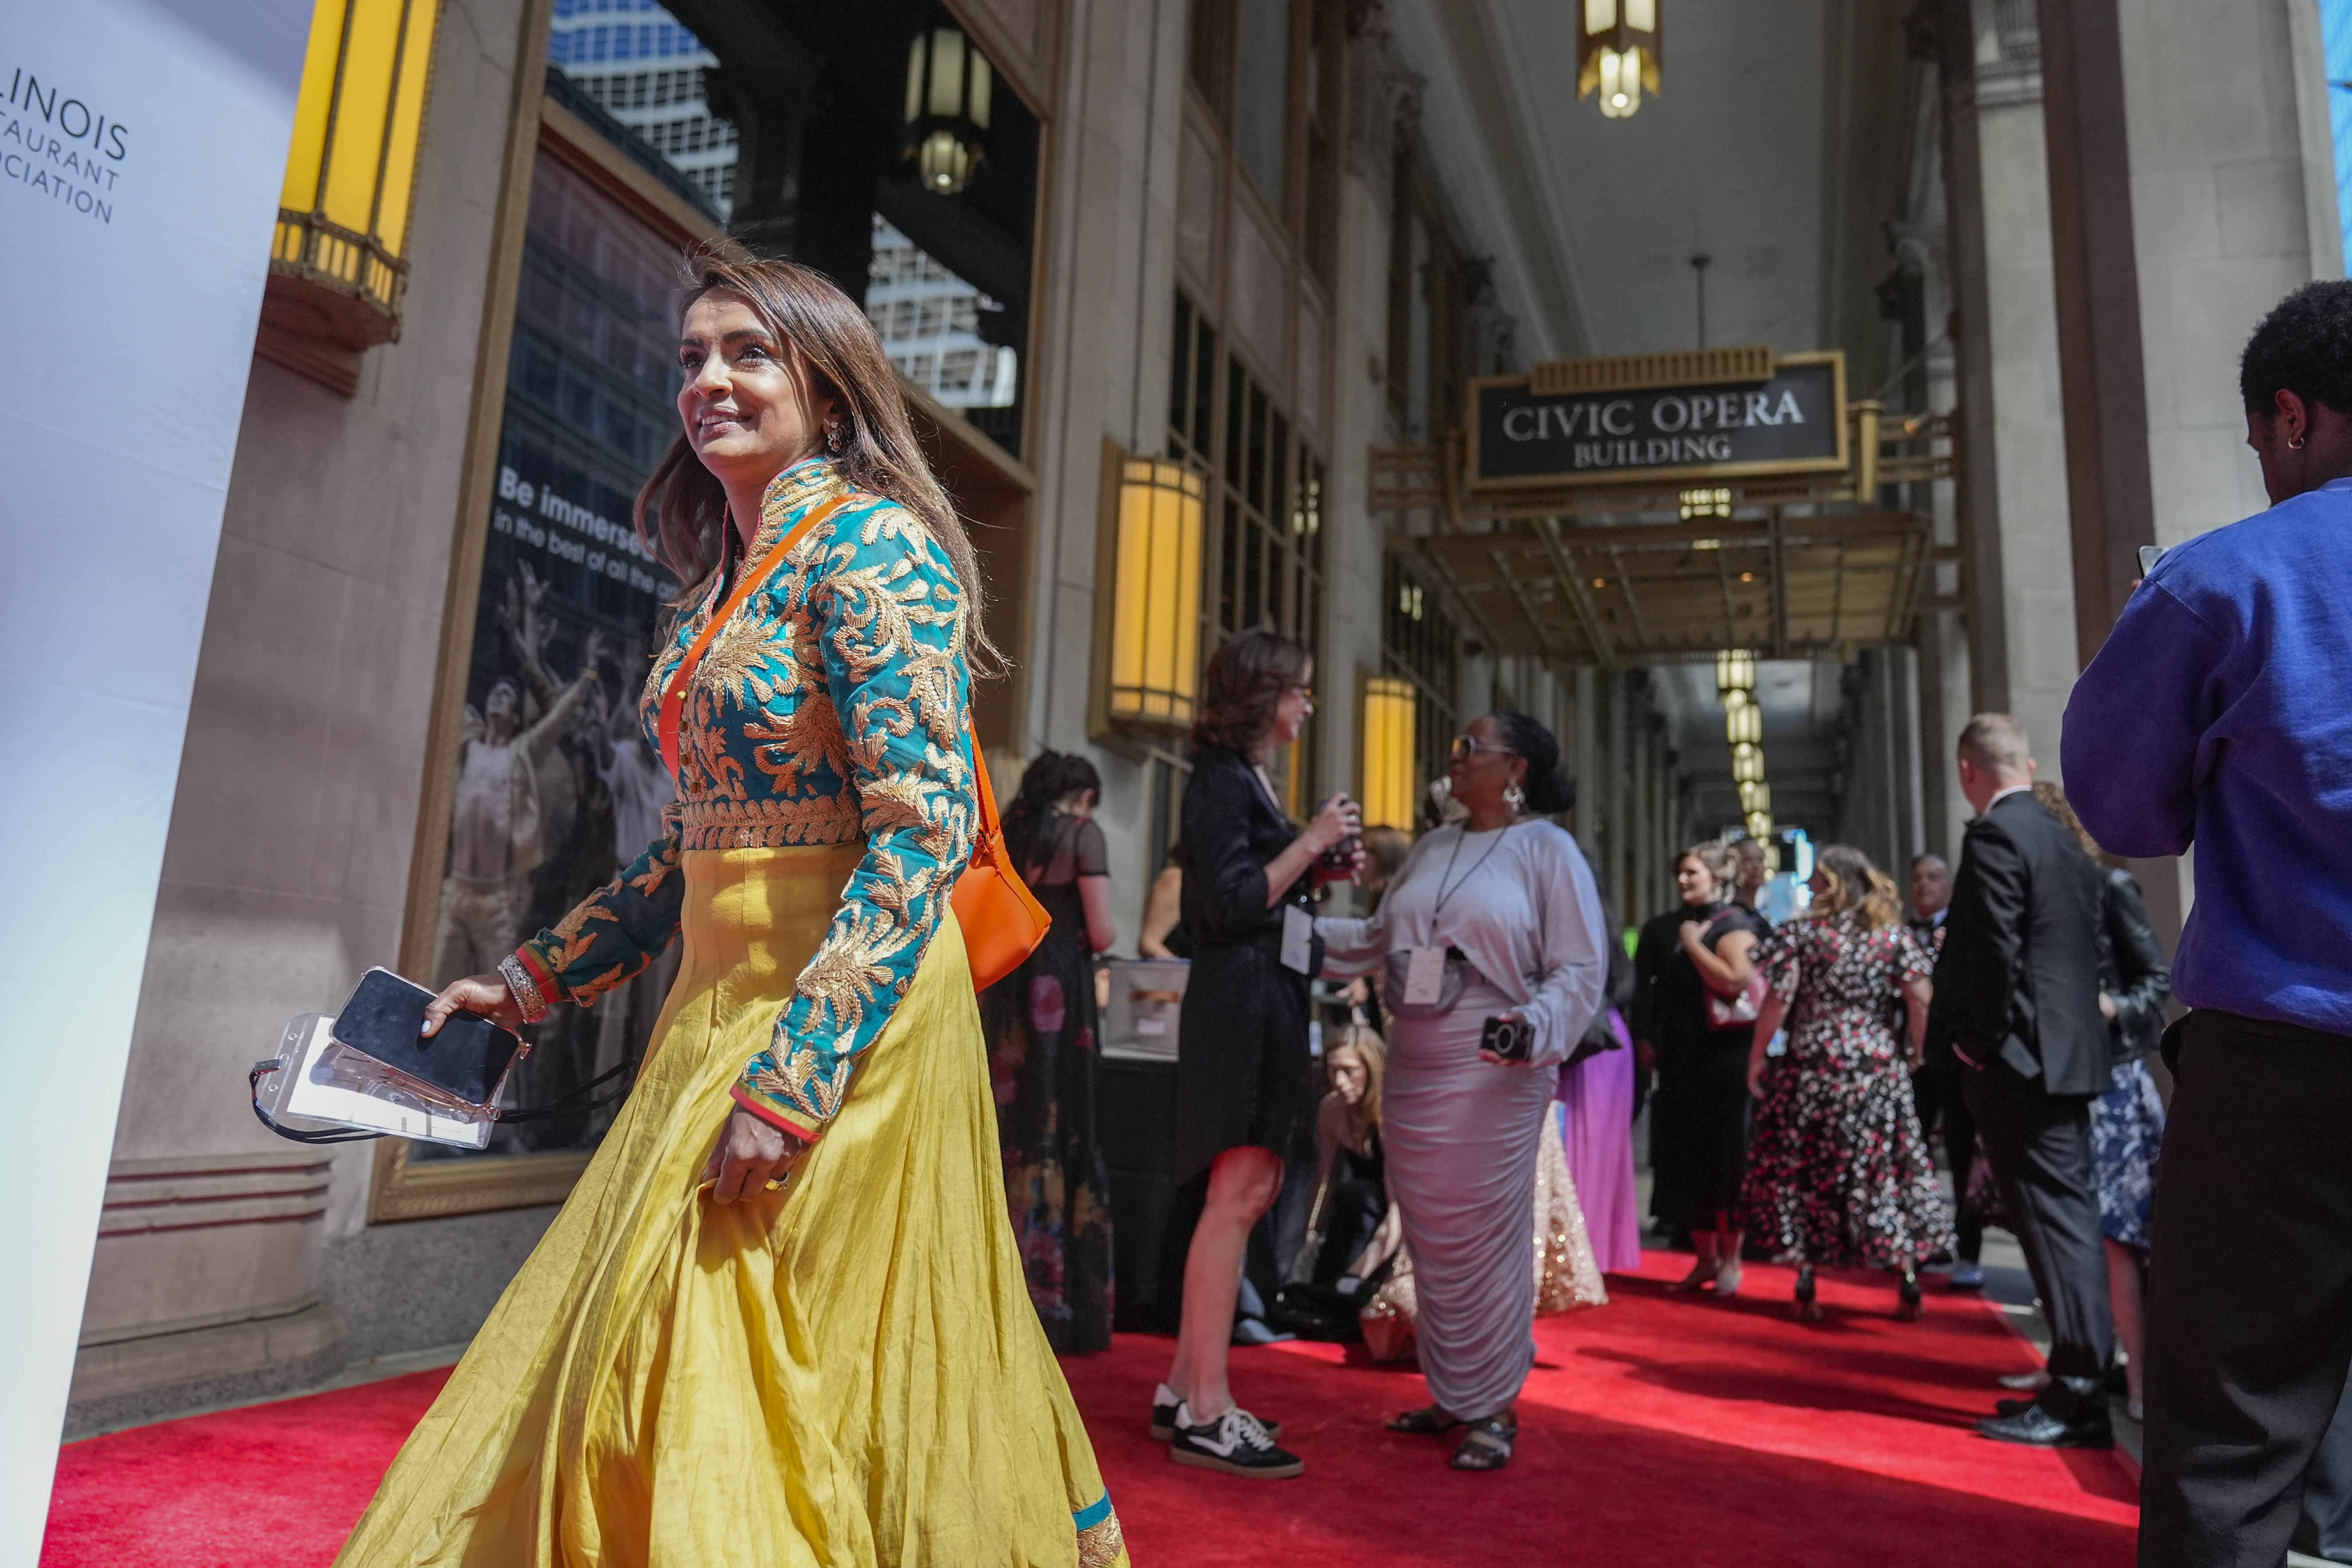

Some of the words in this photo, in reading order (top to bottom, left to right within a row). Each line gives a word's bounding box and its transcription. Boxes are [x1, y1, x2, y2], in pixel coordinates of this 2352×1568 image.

[0, 67, 128, 160] INOIS
[0, 111, 119, 192] AURANT
[0, 150, 113, 224] CIATION
[1502, 399, 1635, 442] CIVIC
[1652, 390, 1805, 432] OPERA
[1573, 433, 1731, 469] BUILDING
[498, 464, 534, 508] Be
[493, 506, 512, 534] in
[514, 515, 546, 548] the
[547, 529, 586, 564] best
[586, 550, 606, 573] of
[605, 558, 628, 582] all
[628, 565, 655, 594] the
